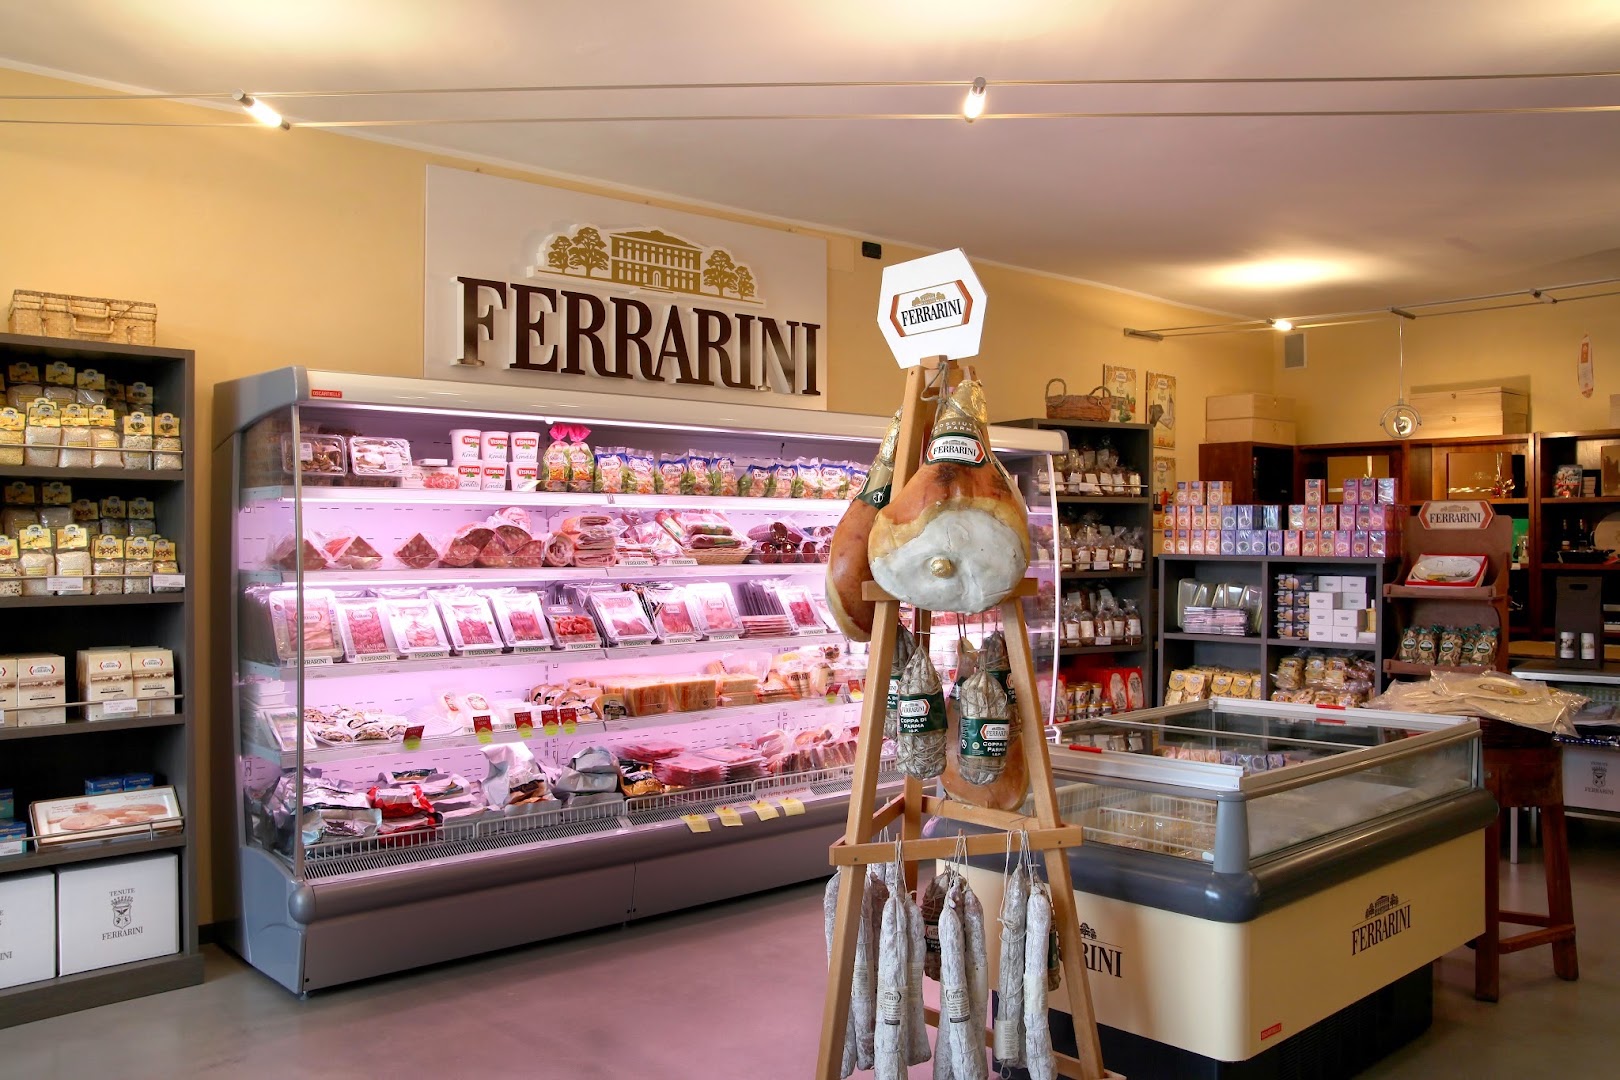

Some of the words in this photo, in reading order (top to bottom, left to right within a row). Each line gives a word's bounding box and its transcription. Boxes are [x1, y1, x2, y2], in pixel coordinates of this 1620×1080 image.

[901, 299, 962, 327] FERRARINI
[450, 276, 821, 396] FERRARINI
[933, 445, 976, 457] FERRARINI
[1429, 512, 1481, 523] FERRARINI
[109, 888, 136, 897] TENUTE
[102, 926, 143, 941] FERRARINI
[1352, 904, 1411, 957] FERRARINI
